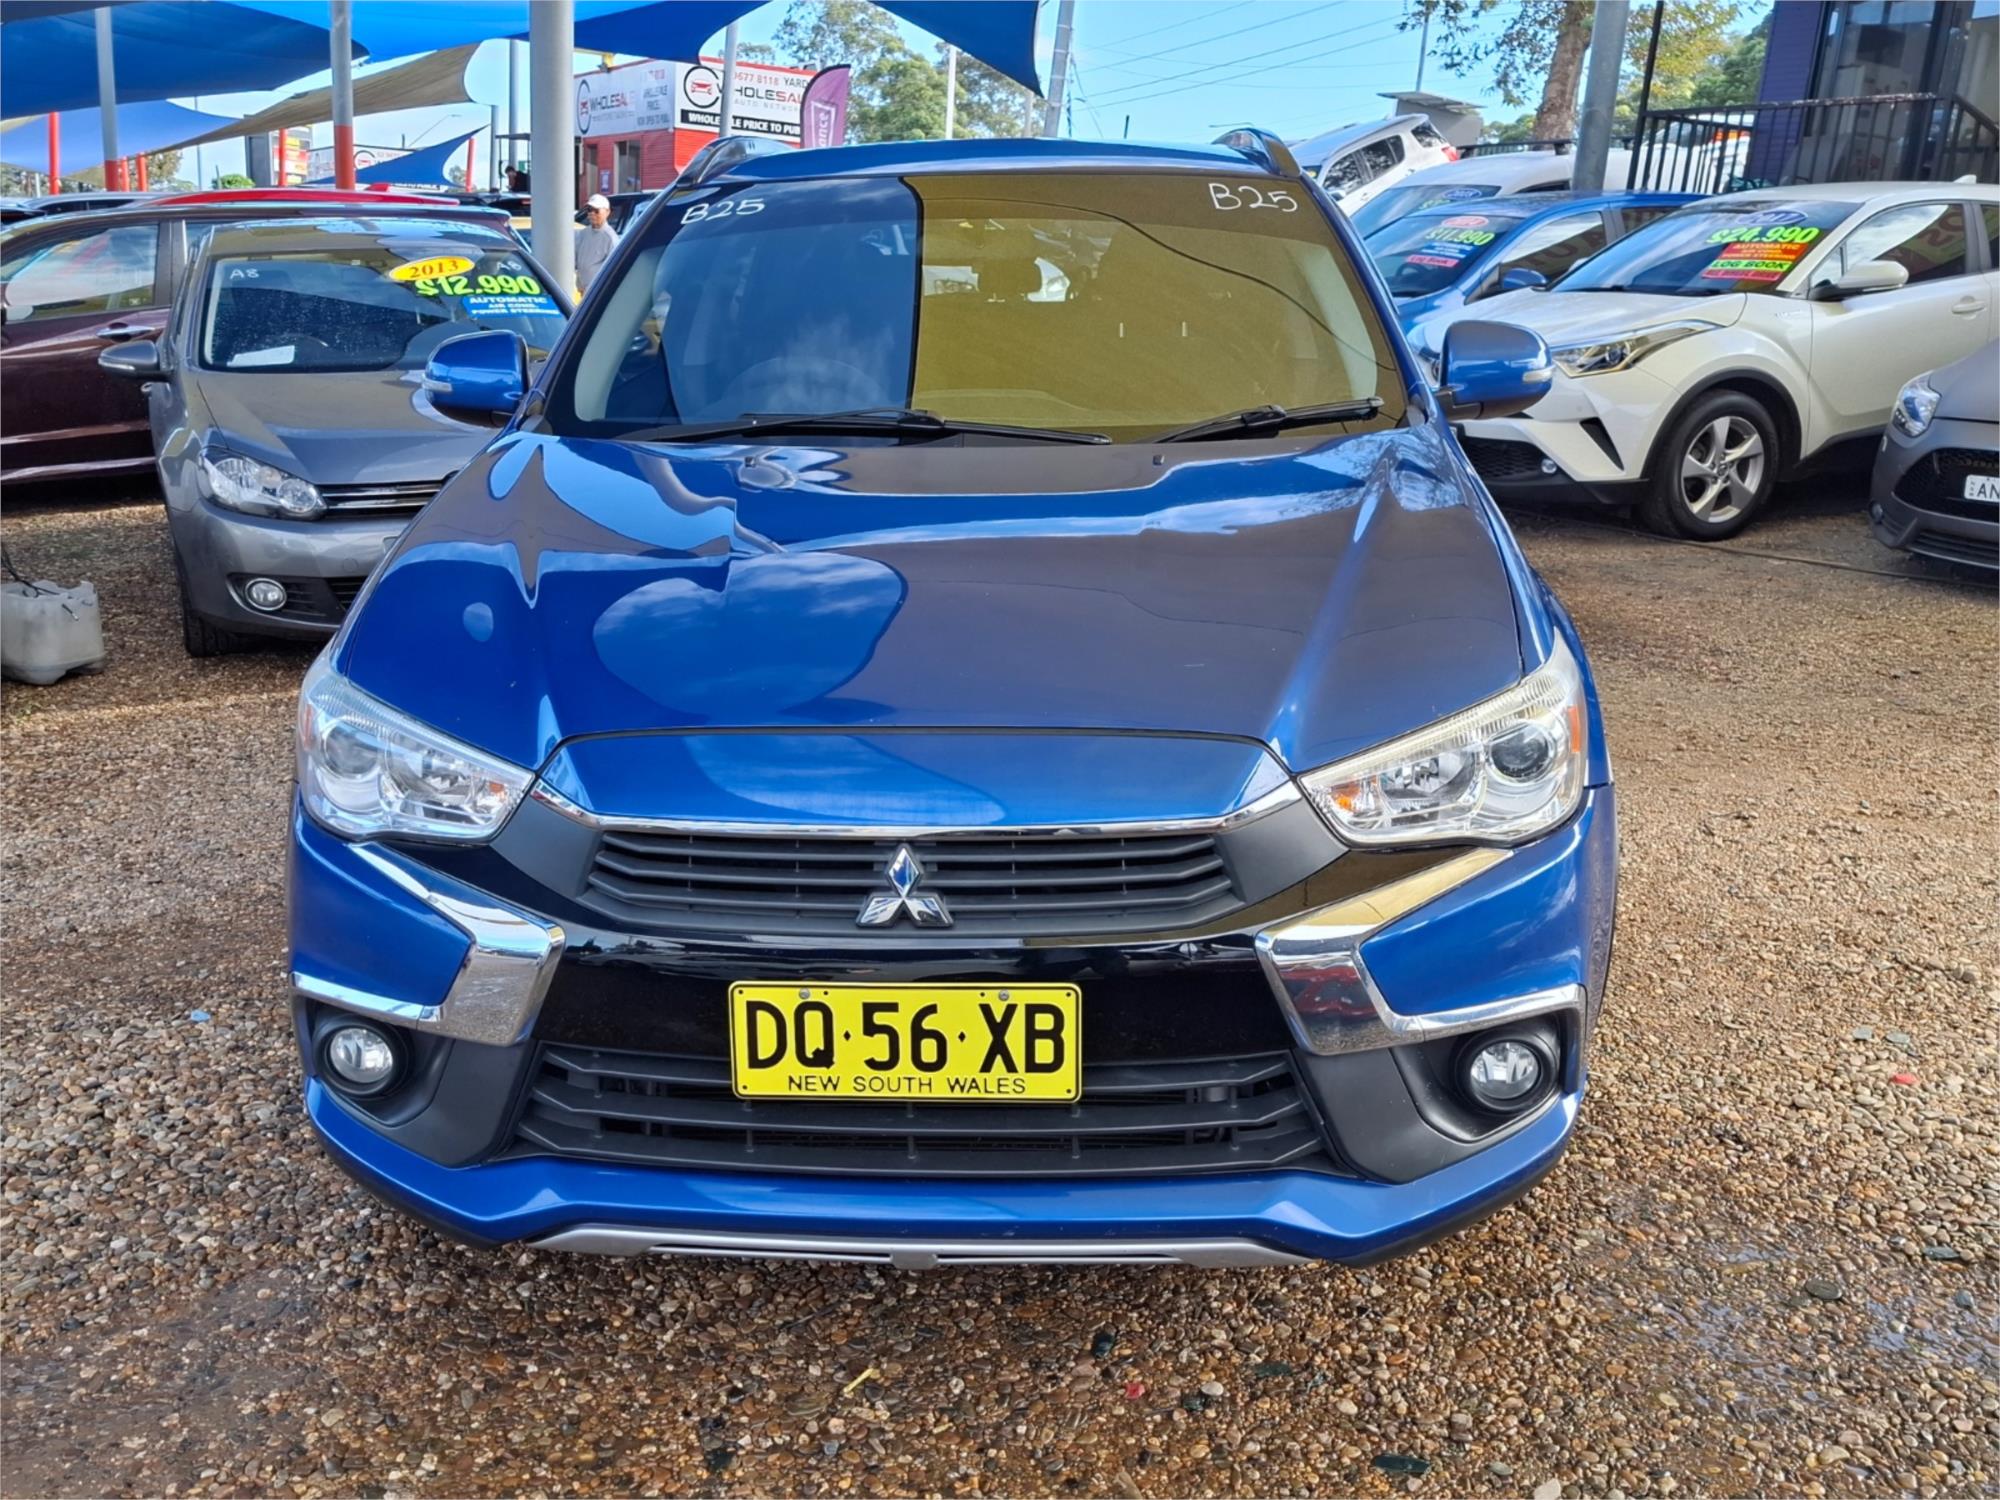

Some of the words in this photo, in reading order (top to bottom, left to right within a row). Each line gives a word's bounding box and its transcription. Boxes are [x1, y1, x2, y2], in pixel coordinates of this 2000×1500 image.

[784, 77, 808, 88] YARD
[763, 101, 800, 111] NETWOR
[743, 119, 768, 131] PRICE
[770, 123, 782, 132] TO
[784, 124, 800, 134] PUB
[1207, 182, 1299, 214] B25
[680, 199, 765, 225] B25
[410, 259, 459, 278] 2013
[1711, 260, 1742, 268] LOG
[1744, 261, 1786, 269] BOOK
[229, 268, 260, 280] A8
[469, 296, 548, 304] AUTOMATIC
[788, 1074, 840, 1092] NEW
[853, 1075, 932, 1093] SOUTH
[946, 1076, 1026, 1095] WALES
